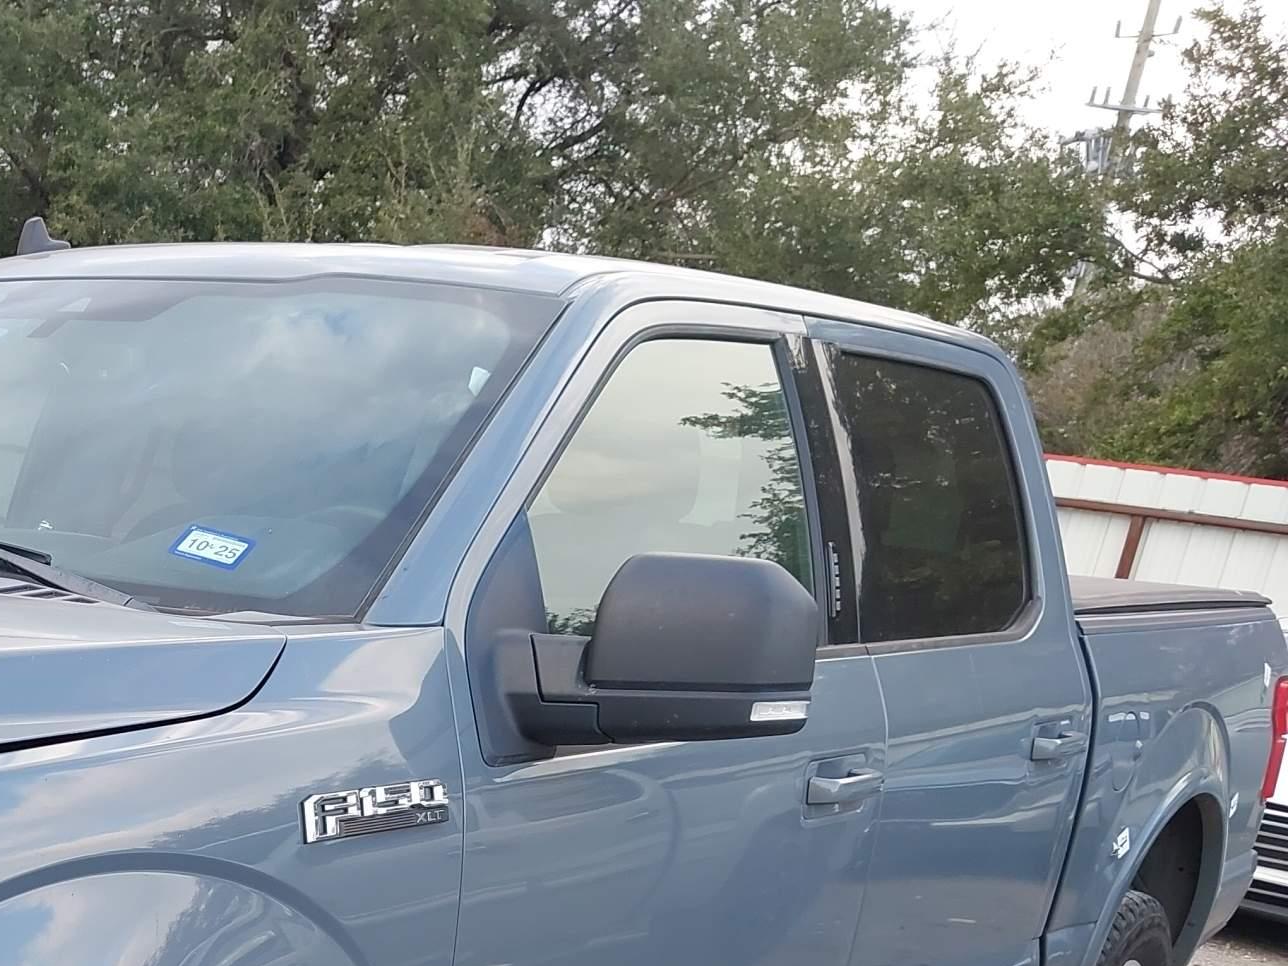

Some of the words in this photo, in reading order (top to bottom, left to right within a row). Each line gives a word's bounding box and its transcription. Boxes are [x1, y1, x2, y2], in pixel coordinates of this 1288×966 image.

[187, 538, 210, 551] 10
[213, 545, 241, 559] 25
[414, 808, 446, 825] XLT
